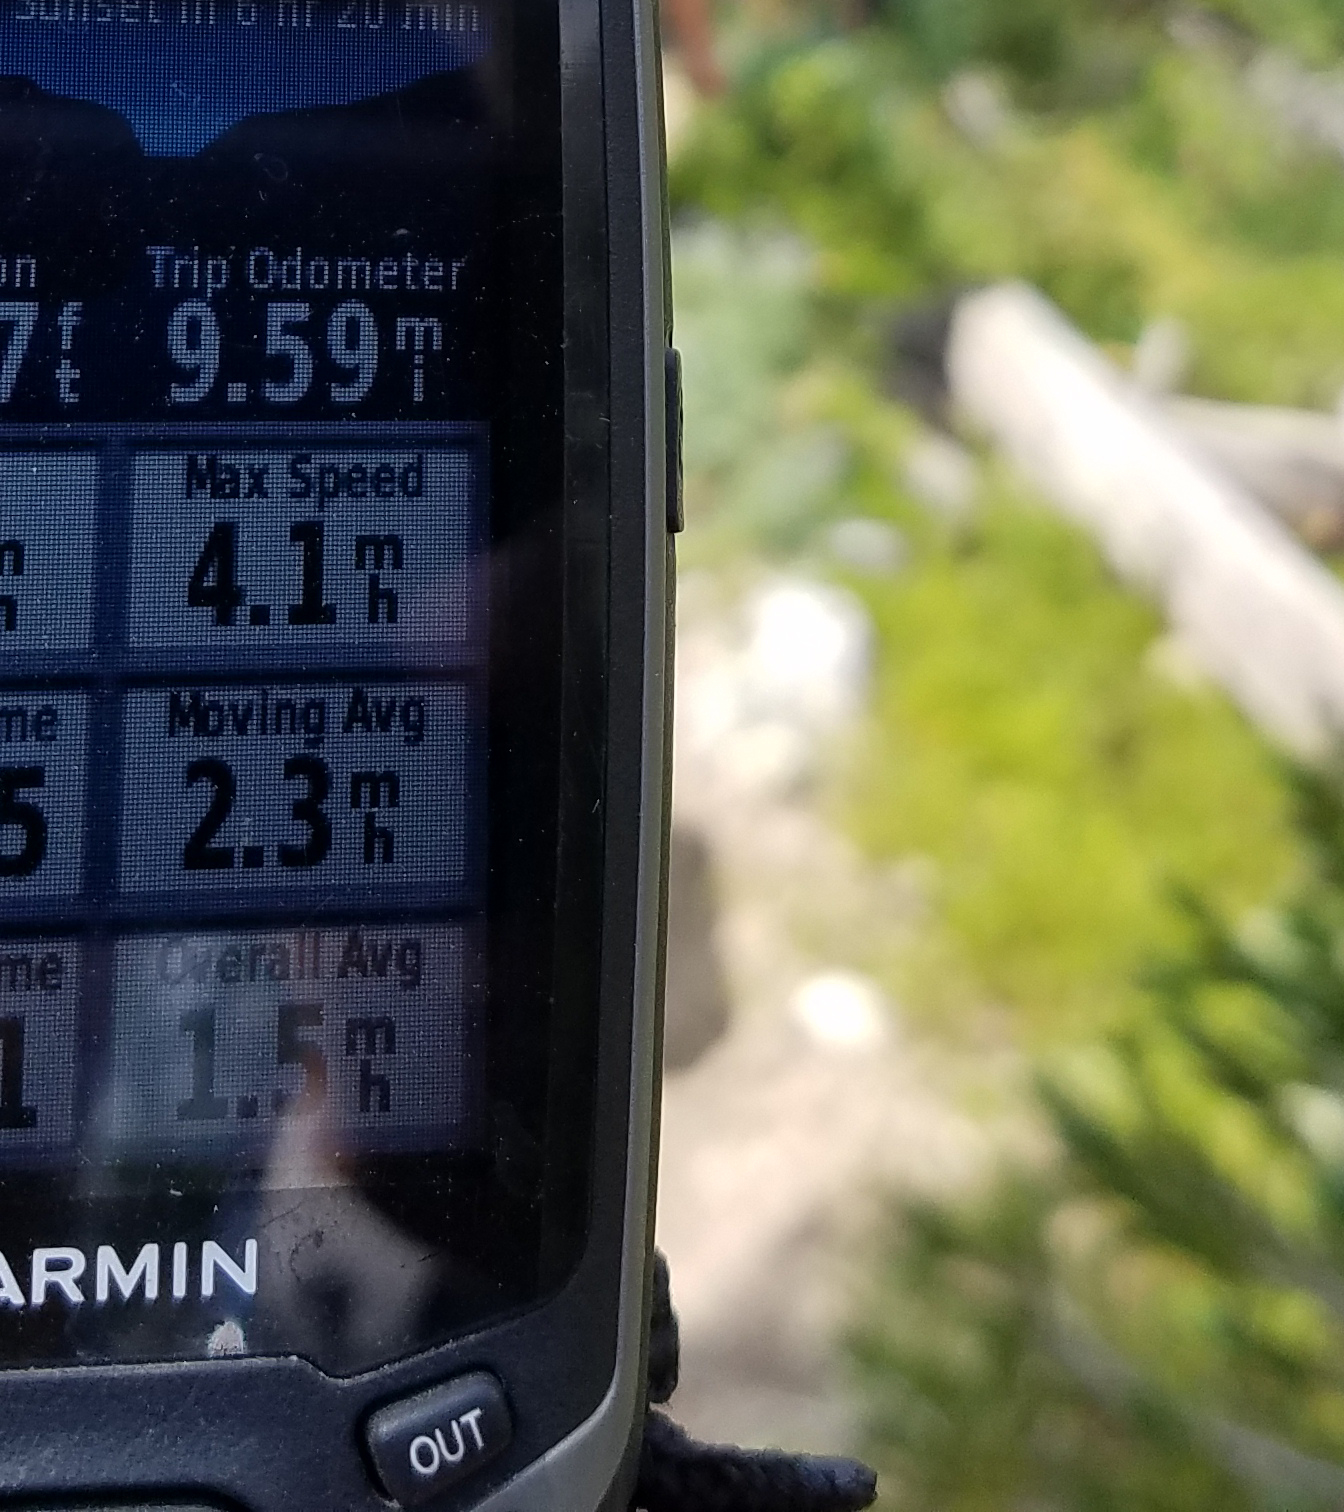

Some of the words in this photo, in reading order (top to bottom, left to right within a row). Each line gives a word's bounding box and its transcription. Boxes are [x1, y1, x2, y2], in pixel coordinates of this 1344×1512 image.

[146, 245, 229, 298] Trip
[247, 245, 467, 290] Odometer
[167, 298, 379, 403] 9.59
[186, 452, 269, 500] Max
[289, 452, 424, 513] Speed
[186, 520, 338, 627] 4.1
[168, 687, 327, 748] Moving
[342, 687, 425, 747] Avg
[183, 755, 332, 870] 2.3
[338, 928, 423, 989] Avg
[176, 1000, 328, 1120] 1.5
[409, 1407, 484, 1476] OUT
